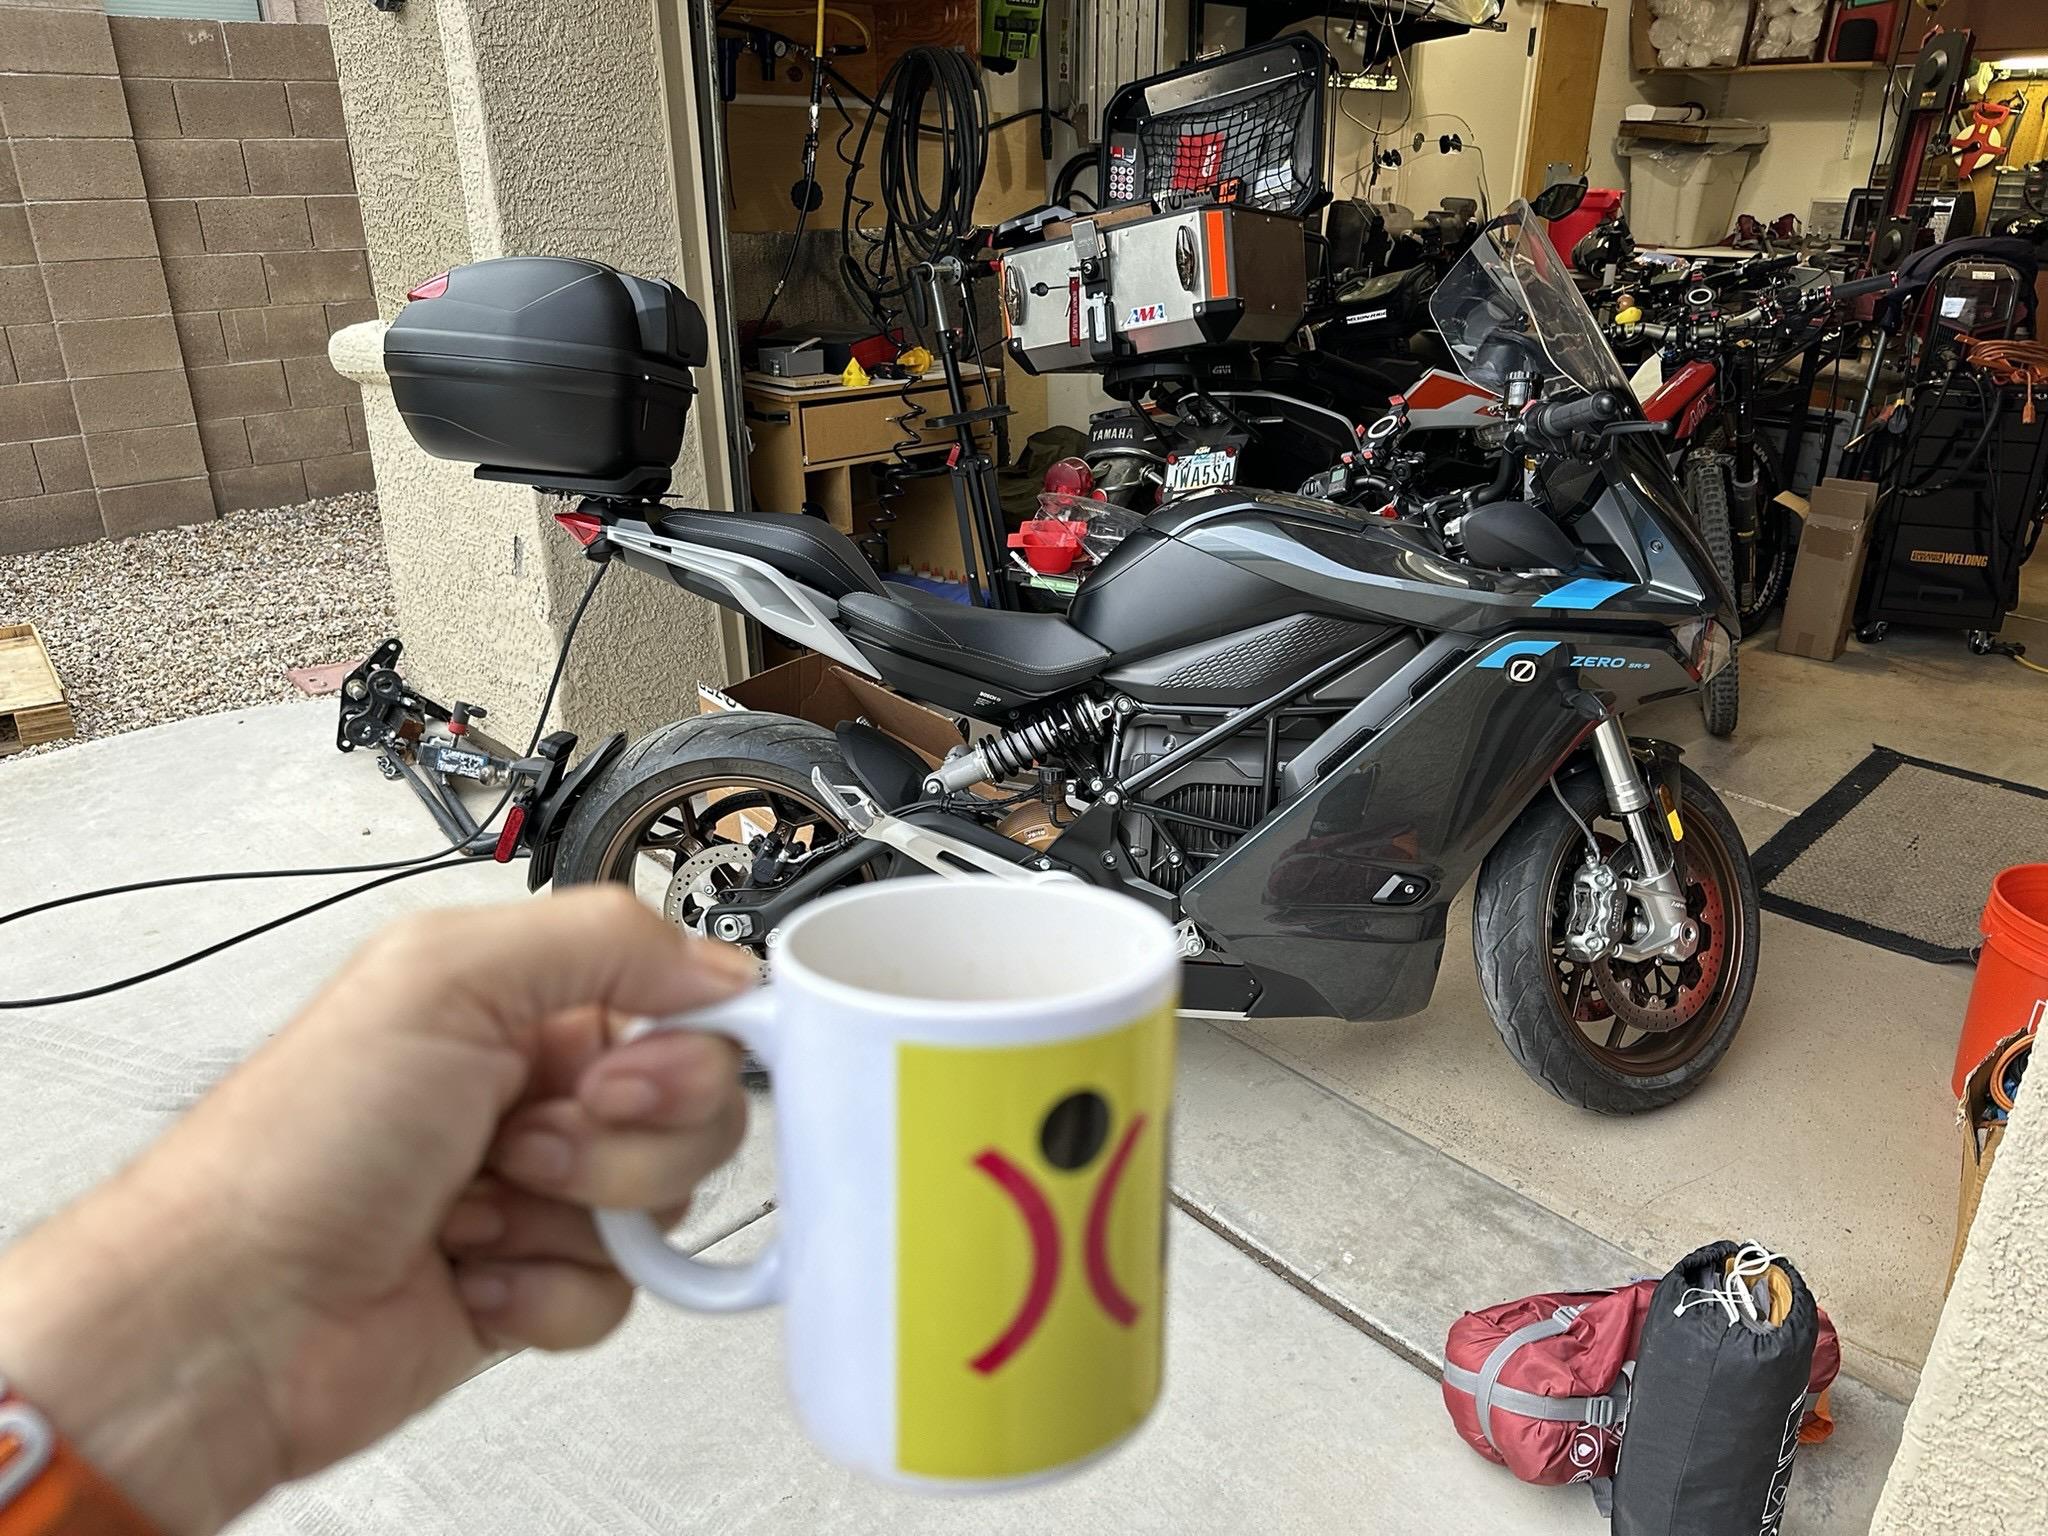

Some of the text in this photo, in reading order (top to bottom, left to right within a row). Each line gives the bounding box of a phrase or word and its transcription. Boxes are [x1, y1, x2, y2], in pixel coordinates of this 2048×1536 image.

[1127, 304, 1166, 325] AMA
[1092, 427, 1134, 442] YAMAHA
[1945, 552, 1989, 567] WELDING
[1570, 655, 1626, 668] ZERO
